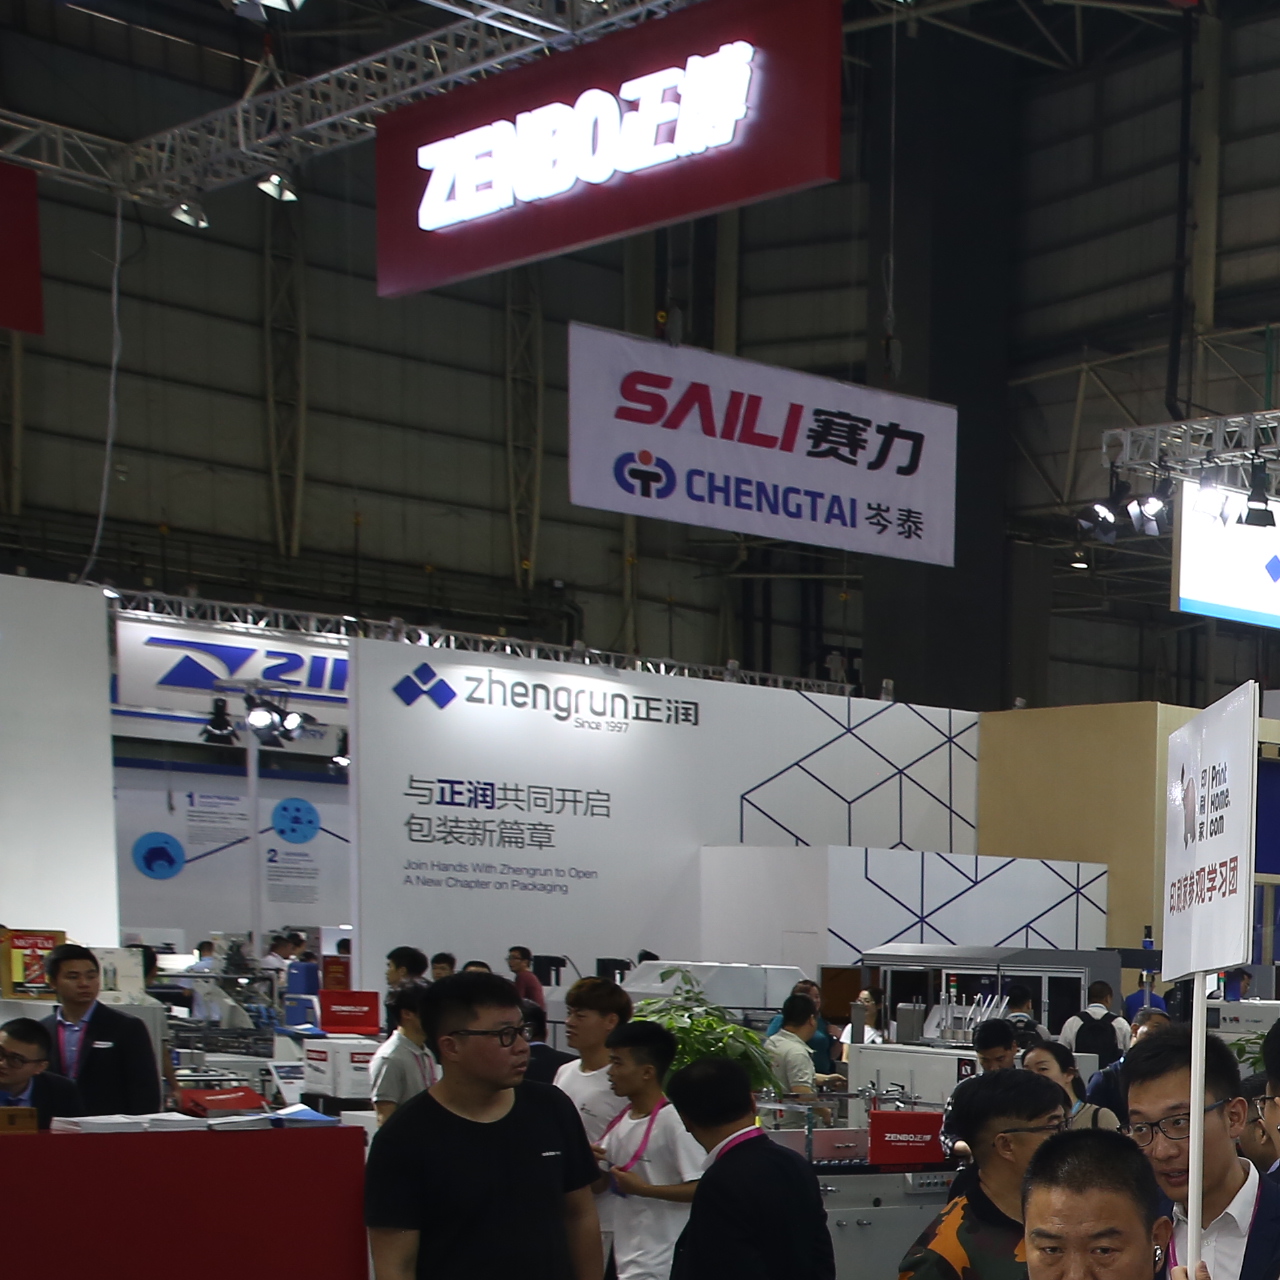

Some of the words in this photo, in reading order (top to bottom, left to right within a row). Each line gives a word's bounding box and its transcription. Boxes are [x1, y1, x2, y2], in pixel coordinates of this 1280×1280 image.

[686, 469, 857, 529] CHENGTAI
[574, 718, 602, 731] Since
[606, 720, 629, 733] 1997
[1211, 761, 1228, 790] Print
[403, 775, 611, 818] 与正润共同开启
[404, 813, 556, 850] 包装新篇章
[1209, 814, 1224, 838] com
[403, 860, 429, 873] Join
[431, 861, 468, 873] Hands
[472, 862, 497, 874] With
[500, 865, 551, 878] Zhengrun
[555, 867, 566, 877] to
[568, 868, 598, 880] Open
[403, 875, 413, 886] A
[416, 876, 442, 888] New
[445, 877, 491, 891] Chapter
[495, 881, 508, 890] on
[510, 879, 568, 894] Packaging
